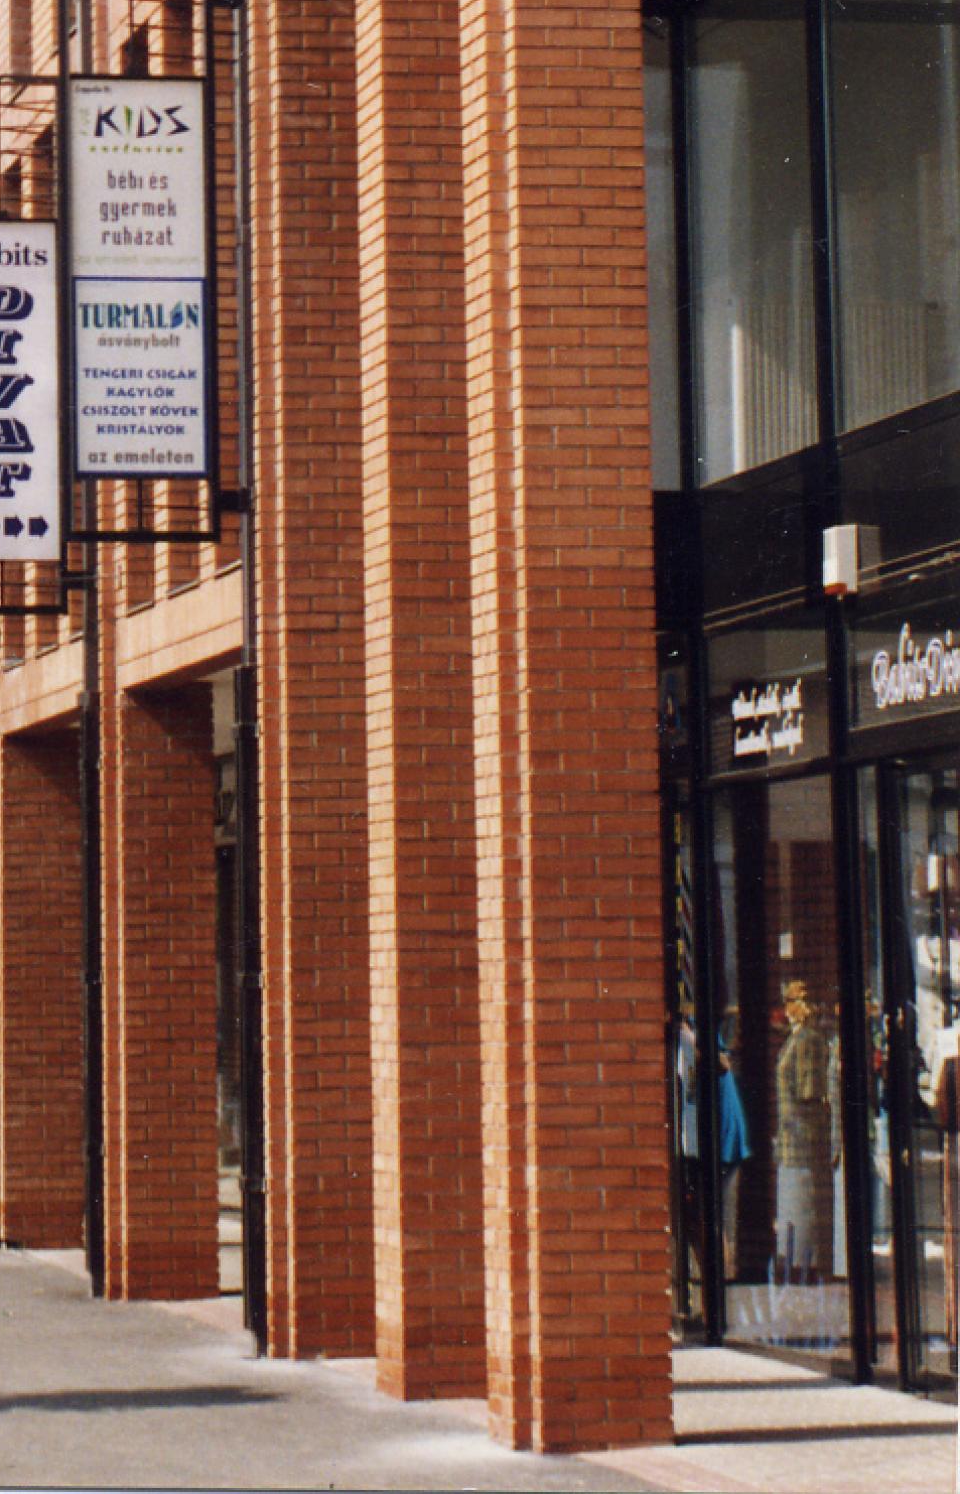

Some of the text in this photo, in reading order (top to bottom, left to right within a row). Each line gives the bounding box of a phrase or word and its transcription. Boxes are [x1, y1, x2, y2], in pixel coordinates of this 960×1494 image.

[94, 106, 191, 138] KIDS
[99, 197, 177, 222] gyermek
[101, 225, 174, 246] ruházat
[97, 332, 181, 351] ásványbolt
[83, 368, 143, 379] TENGERI
[81, 406, 146, 417] CSISZOLT
[88, 447, 195, 464] az emeleten
